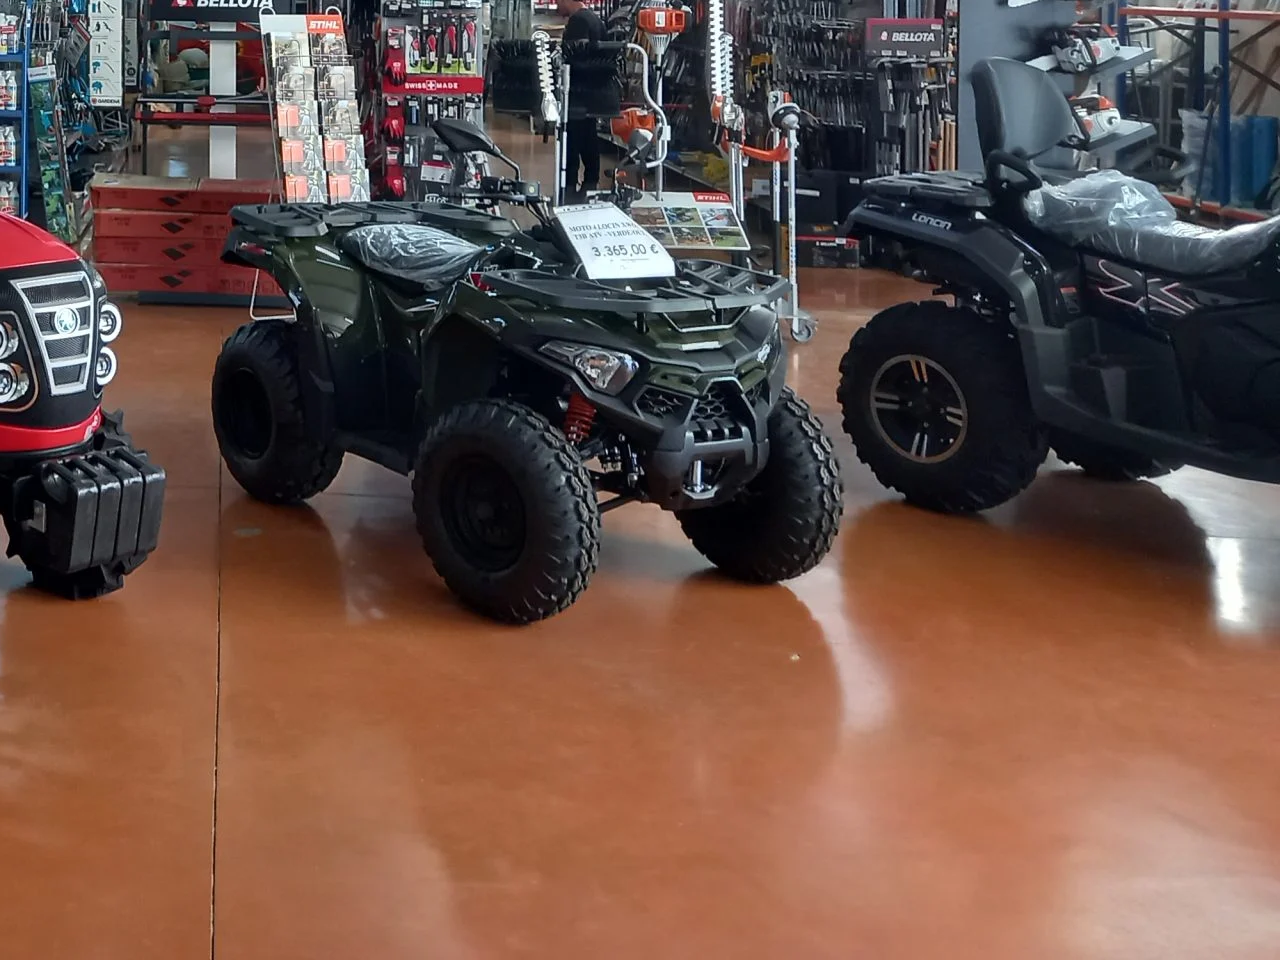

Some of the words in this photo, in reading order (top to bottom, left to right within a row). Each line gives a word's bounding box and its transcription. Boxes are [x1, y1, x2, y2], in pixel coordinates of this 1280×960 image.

[309, 19, 340, 30] STIHL
[891, 32, 936, 42] BELLOTA
[911, 213, 953, 231] LONCIN
[569, 224, 593, 233] MOTO
[592, 244, 646, 257] 3.365,00
[650, 244, 659, 254] €
